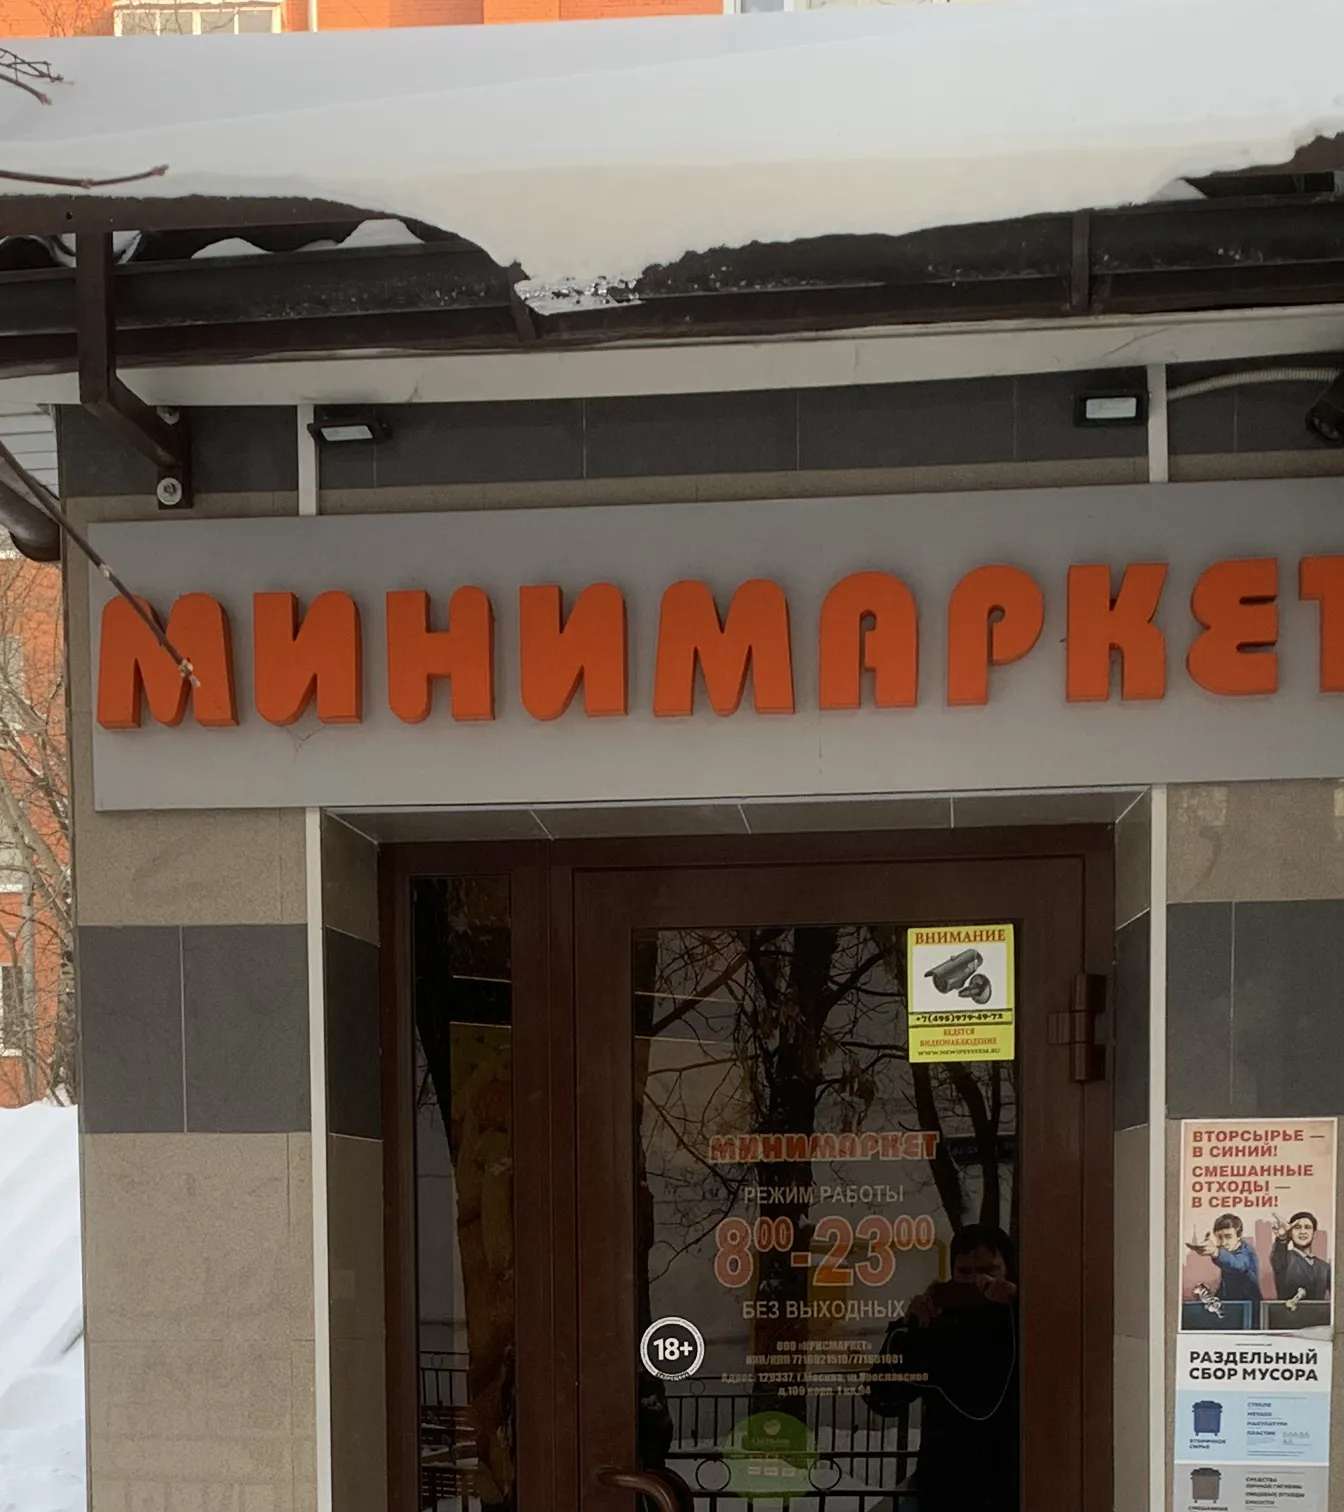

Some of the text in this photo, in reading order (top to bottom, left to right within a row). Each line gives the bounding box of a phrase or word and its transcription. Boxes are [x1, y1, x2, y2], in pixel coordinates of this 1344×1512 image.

[915, 929, 1006, 945] ВНИМАНИЕ
[1192, 1129, 1305, 1143] ВТОРСЫРЬЕ
[708, 1131, 940, 1163] МИНИМАРКЕТ
[1192, 1142, 1278, 1158] В СИНИЙ!
[1191, 1164, 1314, 1178] СМЕШАННЫЕ
[743, 1184, 904, 1204] РЕЖИМ РАБОТЫ
[1191, 1180, 1270, 1195] ОТХОДЫ
[1191, 1193, 1279, 1208] В СЕРЫЙ!
[742, 1299, 905, 1321] БЕЗ ВЫХОДНЫХ
[653, 1337, 693, 1361] 18+
[1189, 1349, 1318, 1366] РАЗДЕЛЬНЫЙ
[1189, 1367, 1318, 1382] СБОР МУСОРА
